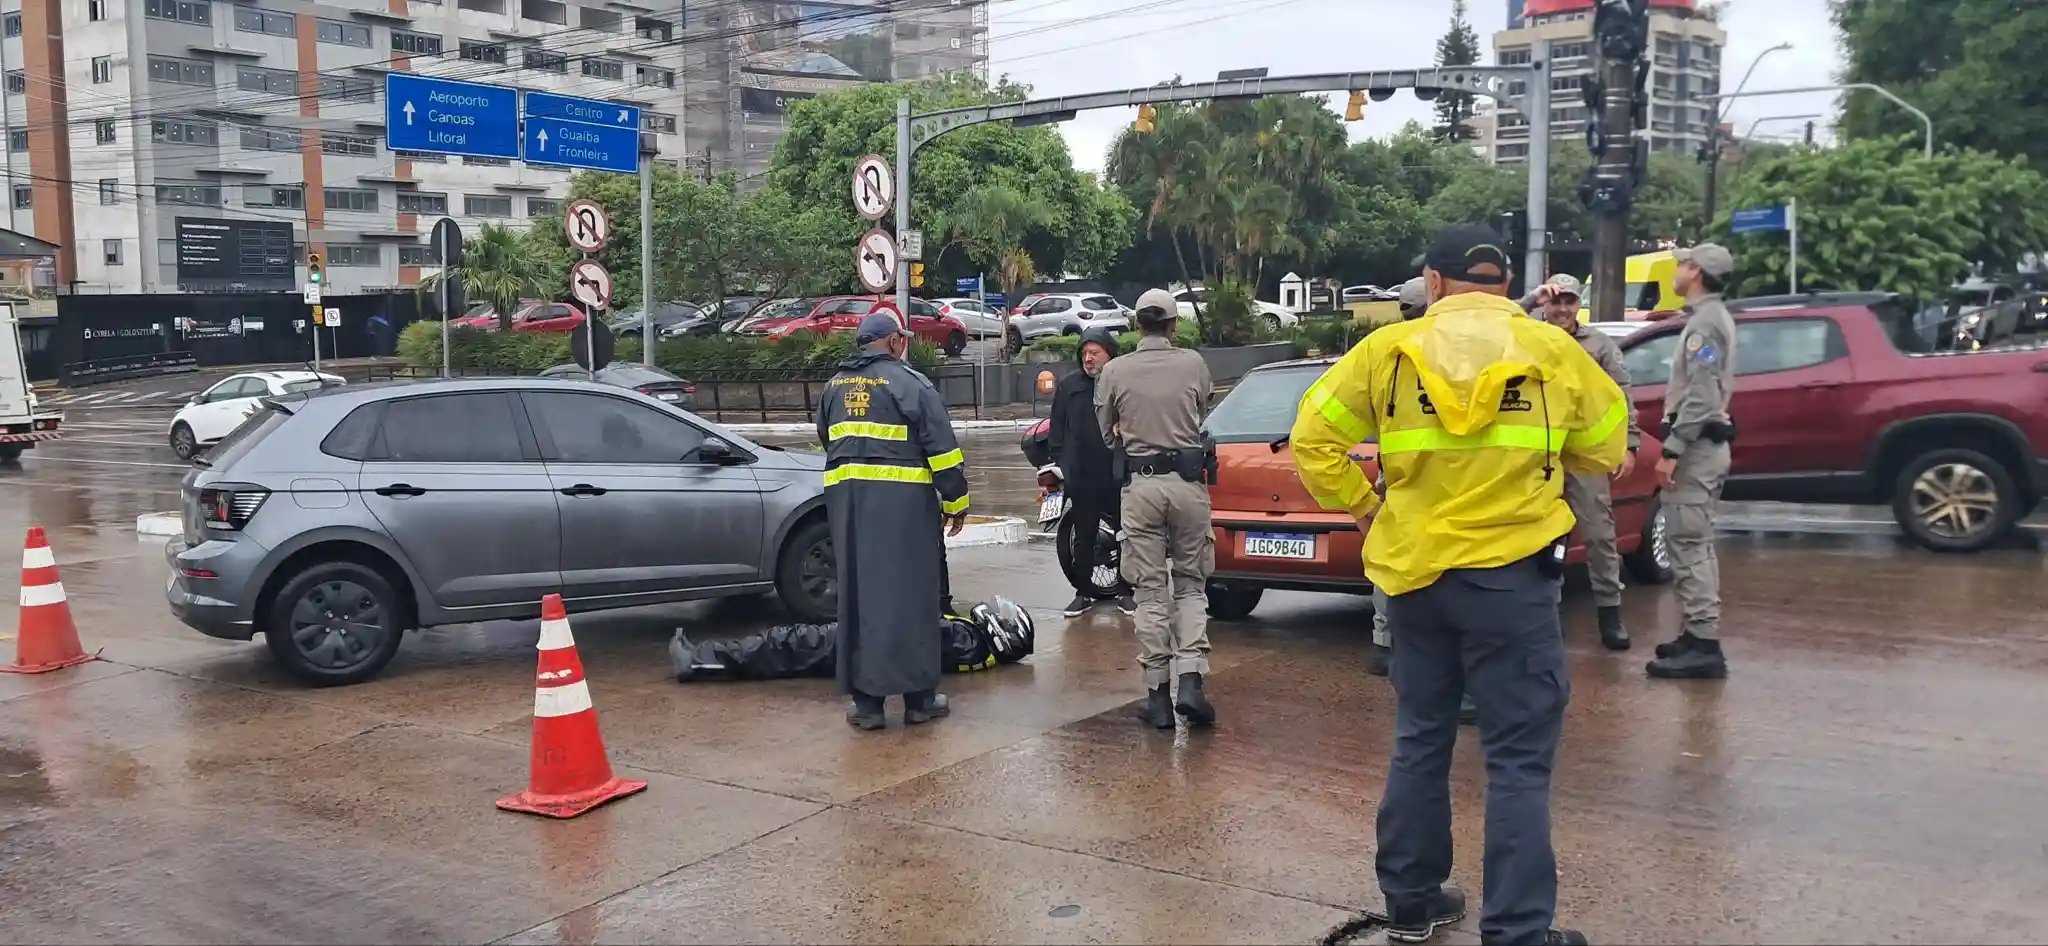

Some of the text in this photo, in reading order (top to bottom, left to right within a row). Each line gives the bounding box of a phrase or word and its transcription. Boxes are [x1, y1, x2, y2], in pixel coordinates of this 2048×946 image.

[428, 90, 489, 107] Aeroporto
[428, 109, 475, 126] Canoas
[565, 103, 603, 119] Centro
[428, 129, 466, 145] Litoral
[559, 127, 600, 144] Guaíba
[558, 144, 609, 161] Fronteira
[831, 375, 890, 387] Fiscalização
[846, 407, 866, 417] 118
[1250, 539, 1306, 556] IGC9B40
